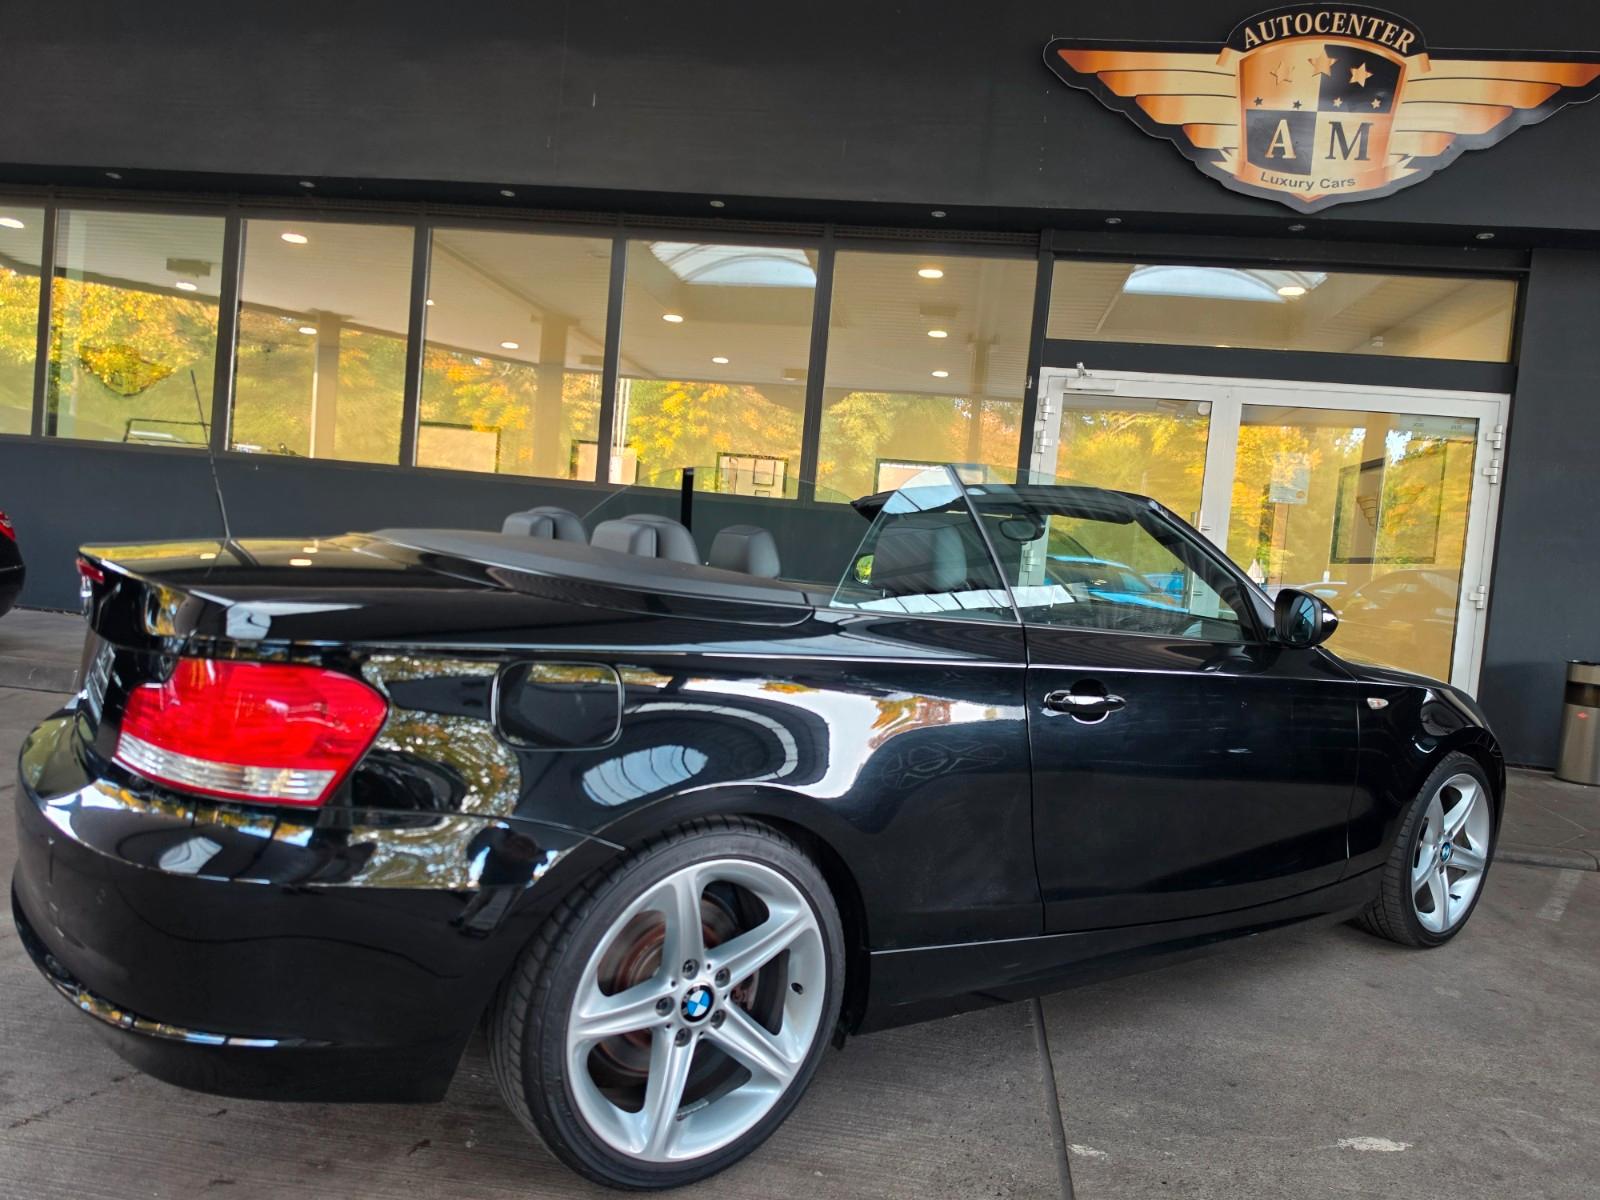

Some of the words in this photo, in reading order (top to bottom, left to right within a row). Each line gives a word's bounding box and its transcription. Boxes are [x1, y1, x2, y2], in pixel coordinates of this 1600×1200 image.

[1244, 11, 1415, 53] AUTOCENTER
[1264, 119, 1297, 159] A
[1325, 121, 1374, 161] M
[1260, 171, 1314, 192] Luxury
[1319, 177, 1356, 189] Cars
